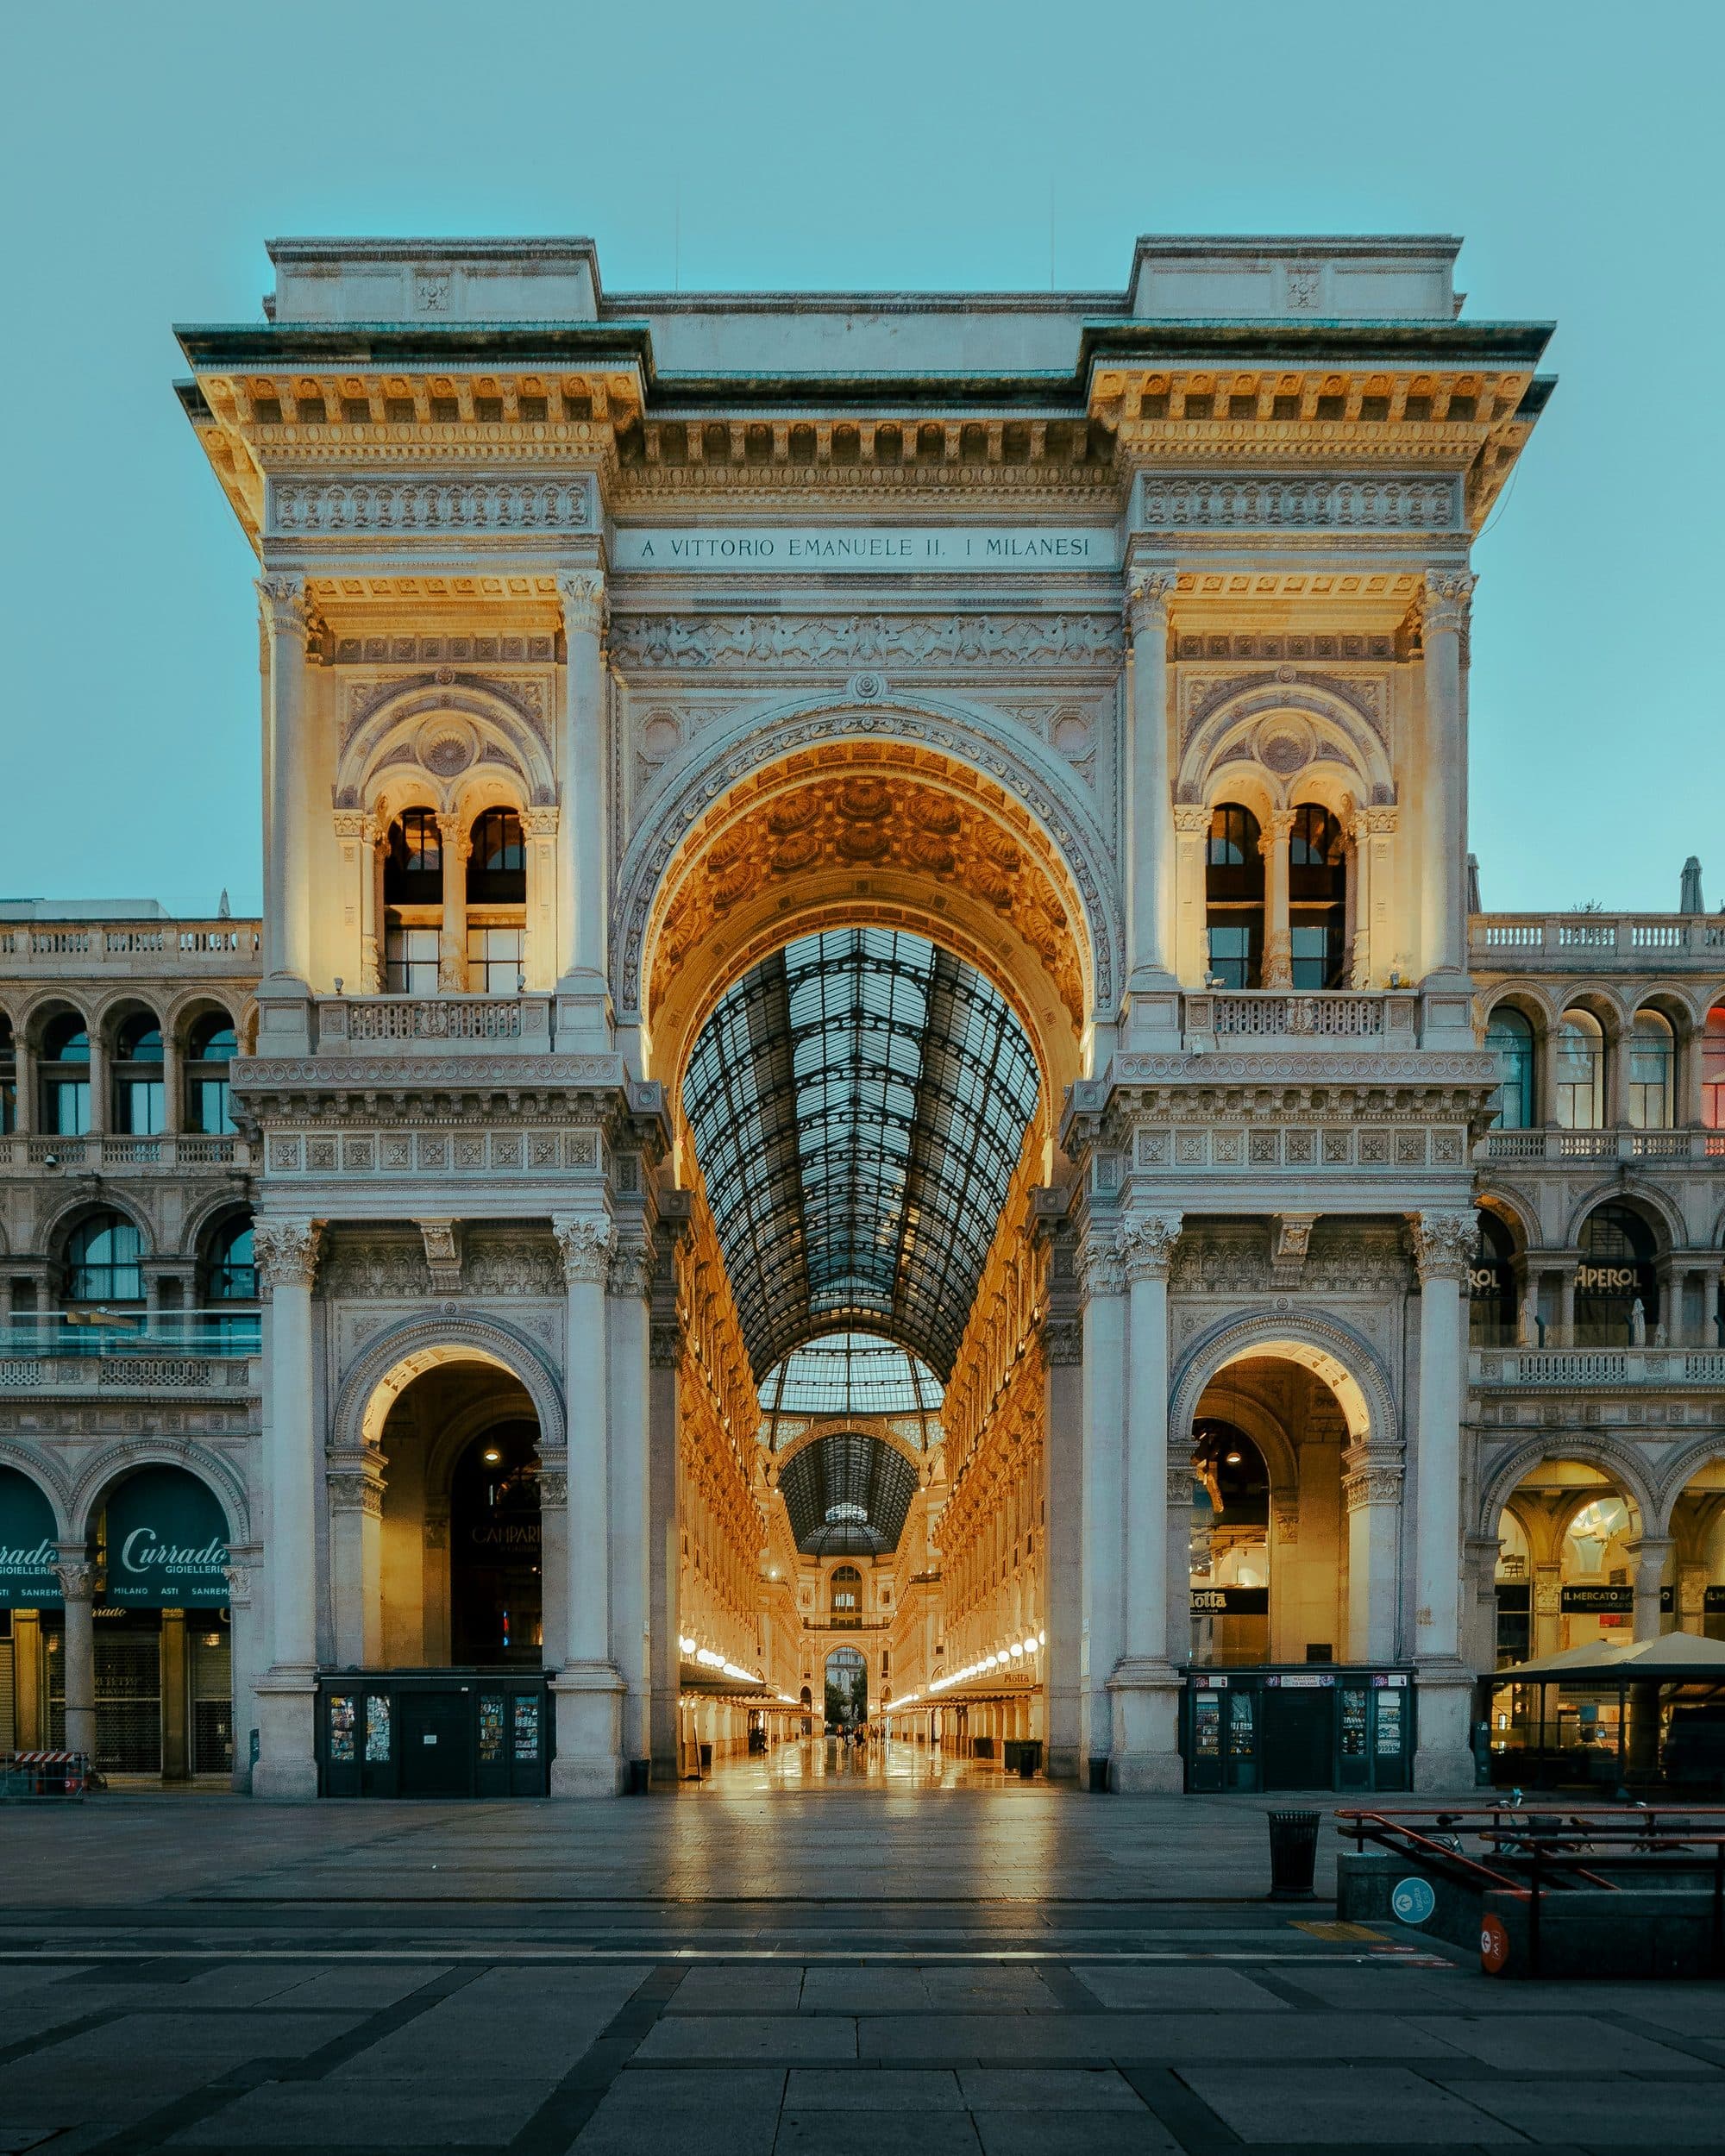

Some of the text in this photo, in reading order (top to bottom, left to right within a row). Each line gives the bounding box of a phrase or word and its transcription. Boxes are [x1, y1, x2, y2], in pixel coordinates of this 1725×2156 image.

[642, 538, 655, 556] A
[671, 538, 775, 556] VITTORIO
[788, 538, 913, 556] EMANUELE
[966, 538, 971, 555] I
[986, 538, 1088, 555] MILANESI
[1469, 1269, 1501, 1288] ROL
[1573, 1264, 1642, 1288] APEROL
[472, 1525, 540, 1544] CAMPARI
[0, 1539, 57, 1565] rado
[122, 1527, 228, 1573] Currado
[1564, 1592, 1573, 1601] IL
[1573, 1592, 1618, 1601] MERCATO
[1004, 1673, 1029, 1683] Motta
